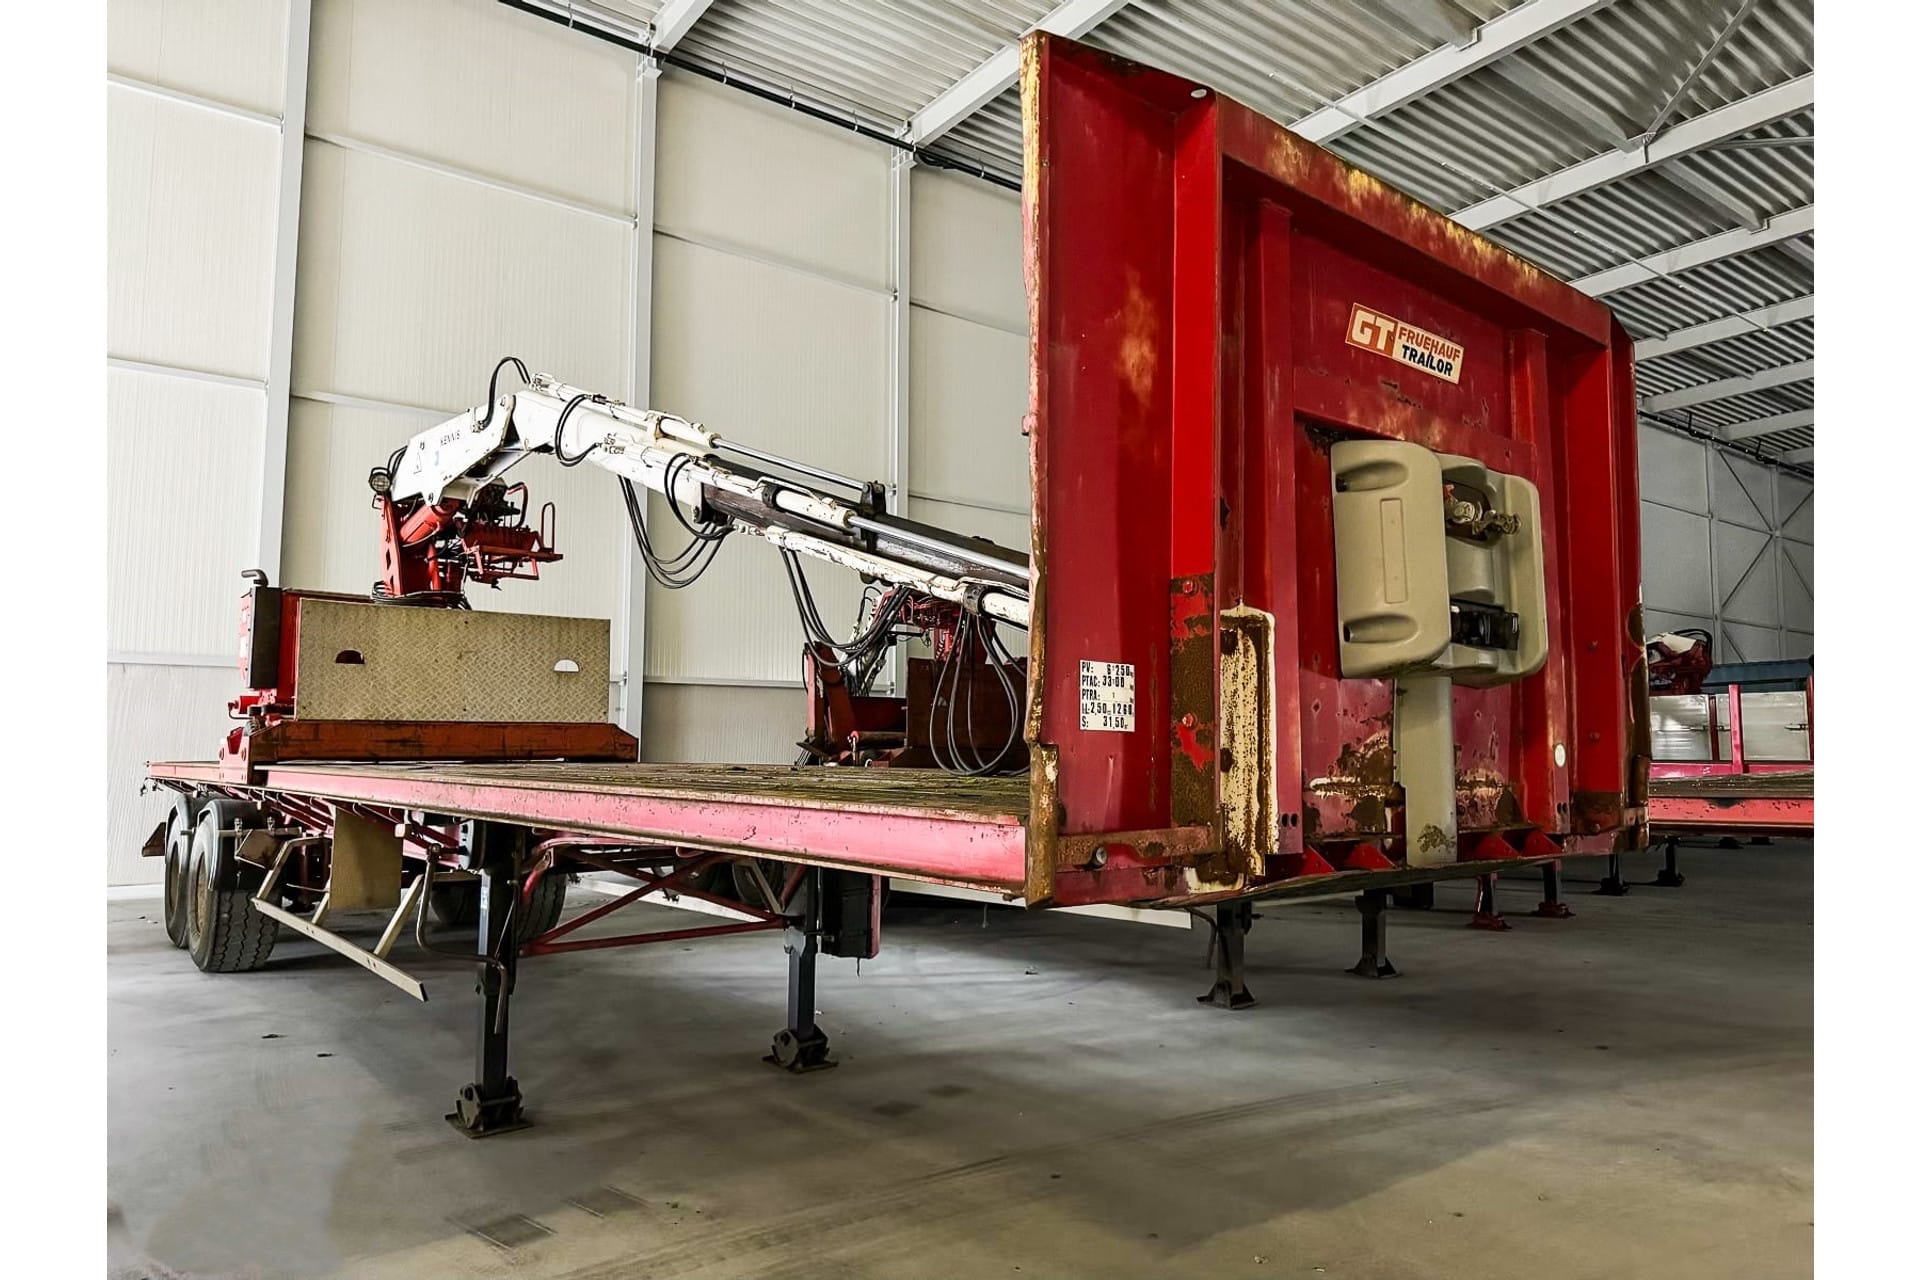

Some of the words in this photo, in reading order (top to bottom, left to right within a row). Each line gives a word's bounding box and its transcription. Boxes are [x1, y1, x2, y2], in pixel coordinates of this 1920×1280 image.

[1352, 310, 1395, 351] GT
[1398, 327, 1460, 361] FRUEHAUF
[1402, 344, 1453, 376] TRAILOR
[1082, 675, 1101, 687] PTAC:
